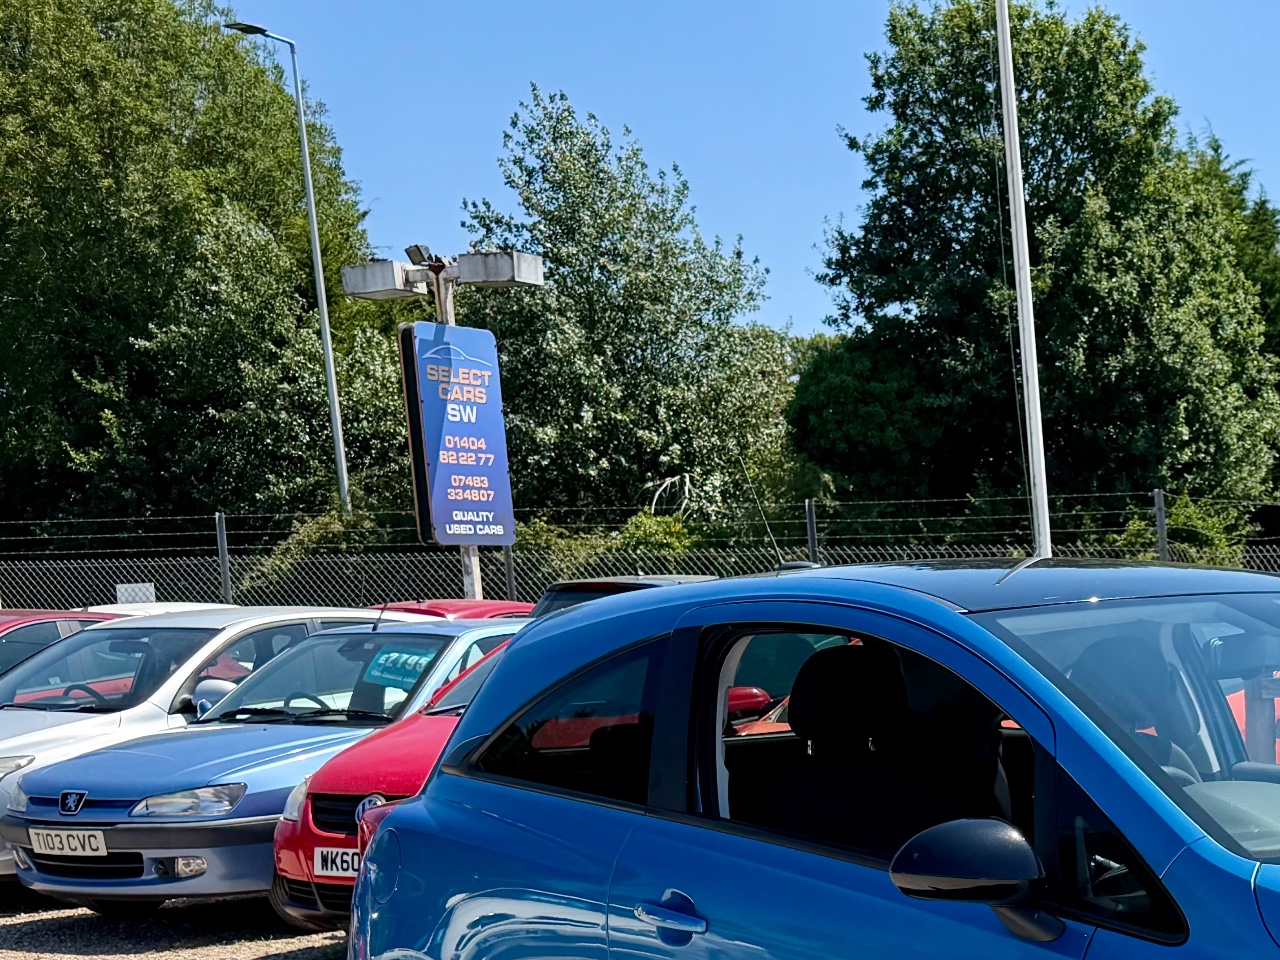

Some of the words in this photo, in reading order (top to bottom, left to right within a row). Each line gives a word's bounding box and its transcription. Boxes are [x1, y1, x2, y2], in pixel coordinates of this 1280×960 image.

[427, 365, 492, 386] SELECT
[438, 385, 487, 403] CARS
[447, 404, 477, 423] SW
[445, 435, 487, 450] 01404
[451, 475, 489, 488] 07483
[447, 488, 494, 502] 334807
[452, 511, 494, 522] QUALITY
[446, 524, 474, 534] USED
[476, 525, 504, 535] CARS
[377, 652, 431, 672] £2795
[67, 833, 100, 852] CVC
